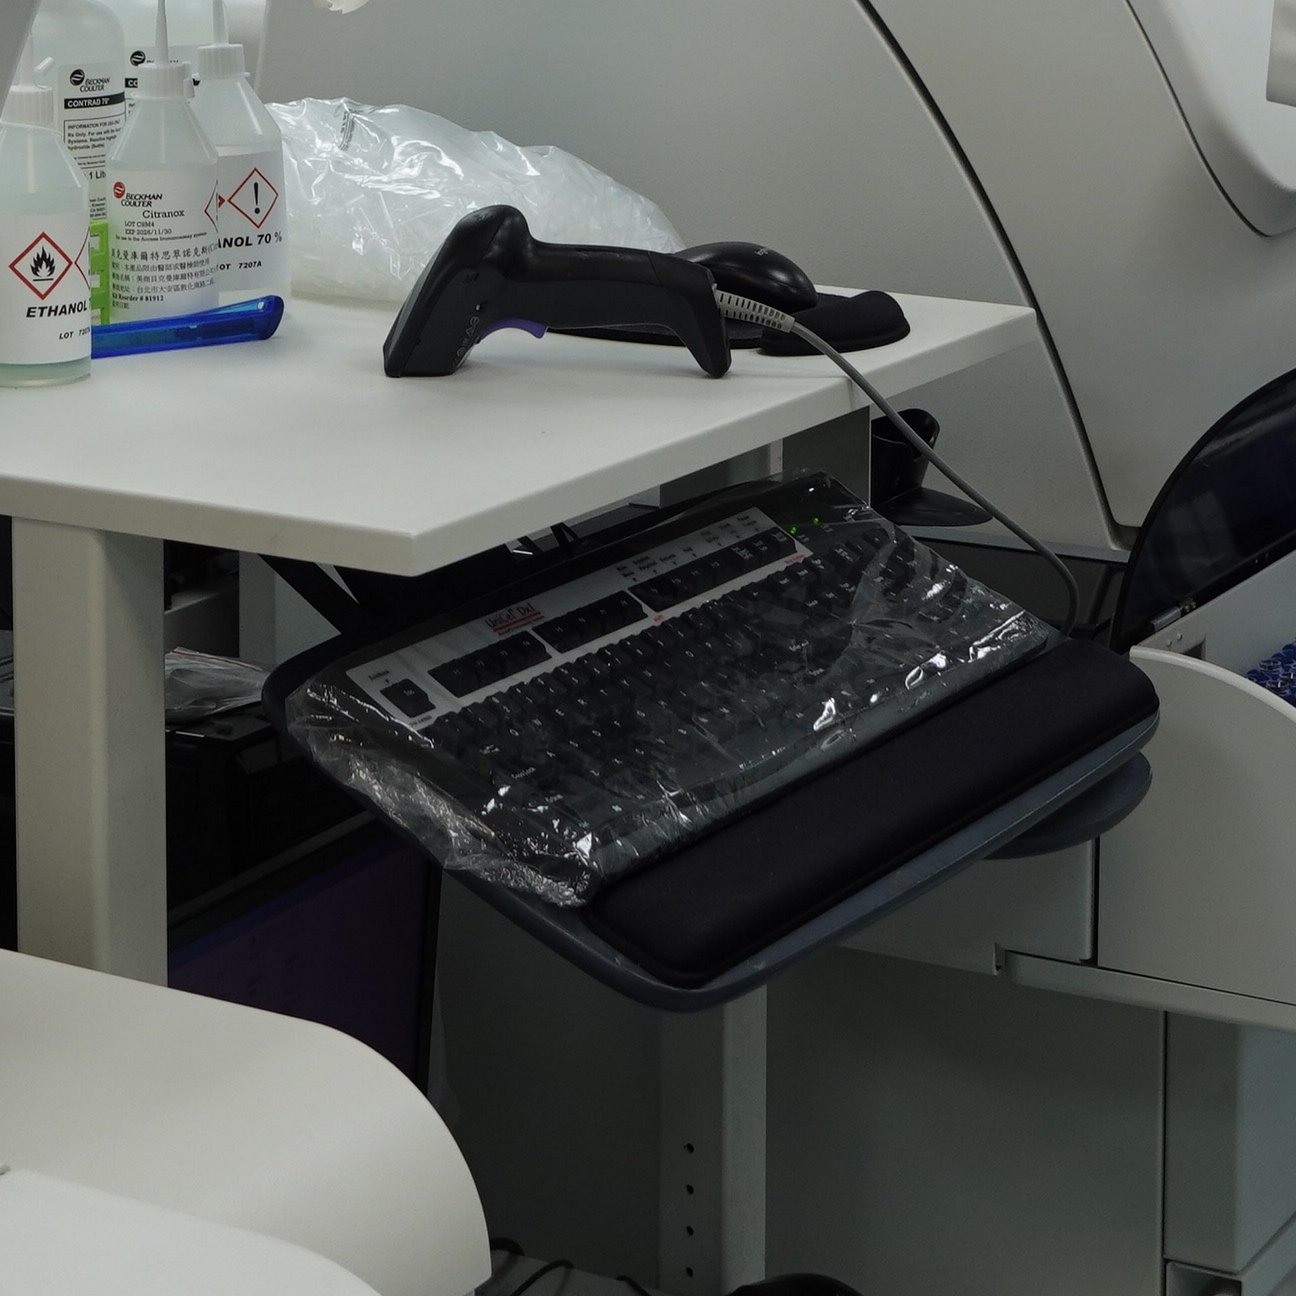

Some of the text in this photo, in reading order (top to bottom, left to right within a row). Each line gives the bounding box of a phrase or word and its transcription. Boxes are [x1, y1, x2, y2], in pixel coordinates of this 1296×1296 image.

[67, 97, 101, 108] CONTRAD
[125, 193, 163, 201] BECKMAN
[120, 199, 153, 207] COULTER
[142, 210, 185, 219] Citranox
[257, 233, 272, 246] 70
[238, 260, 262, 269] 7207A
[25, 300, 88, 318] ETHANOL
[58, 330, 74, 340] LOT
